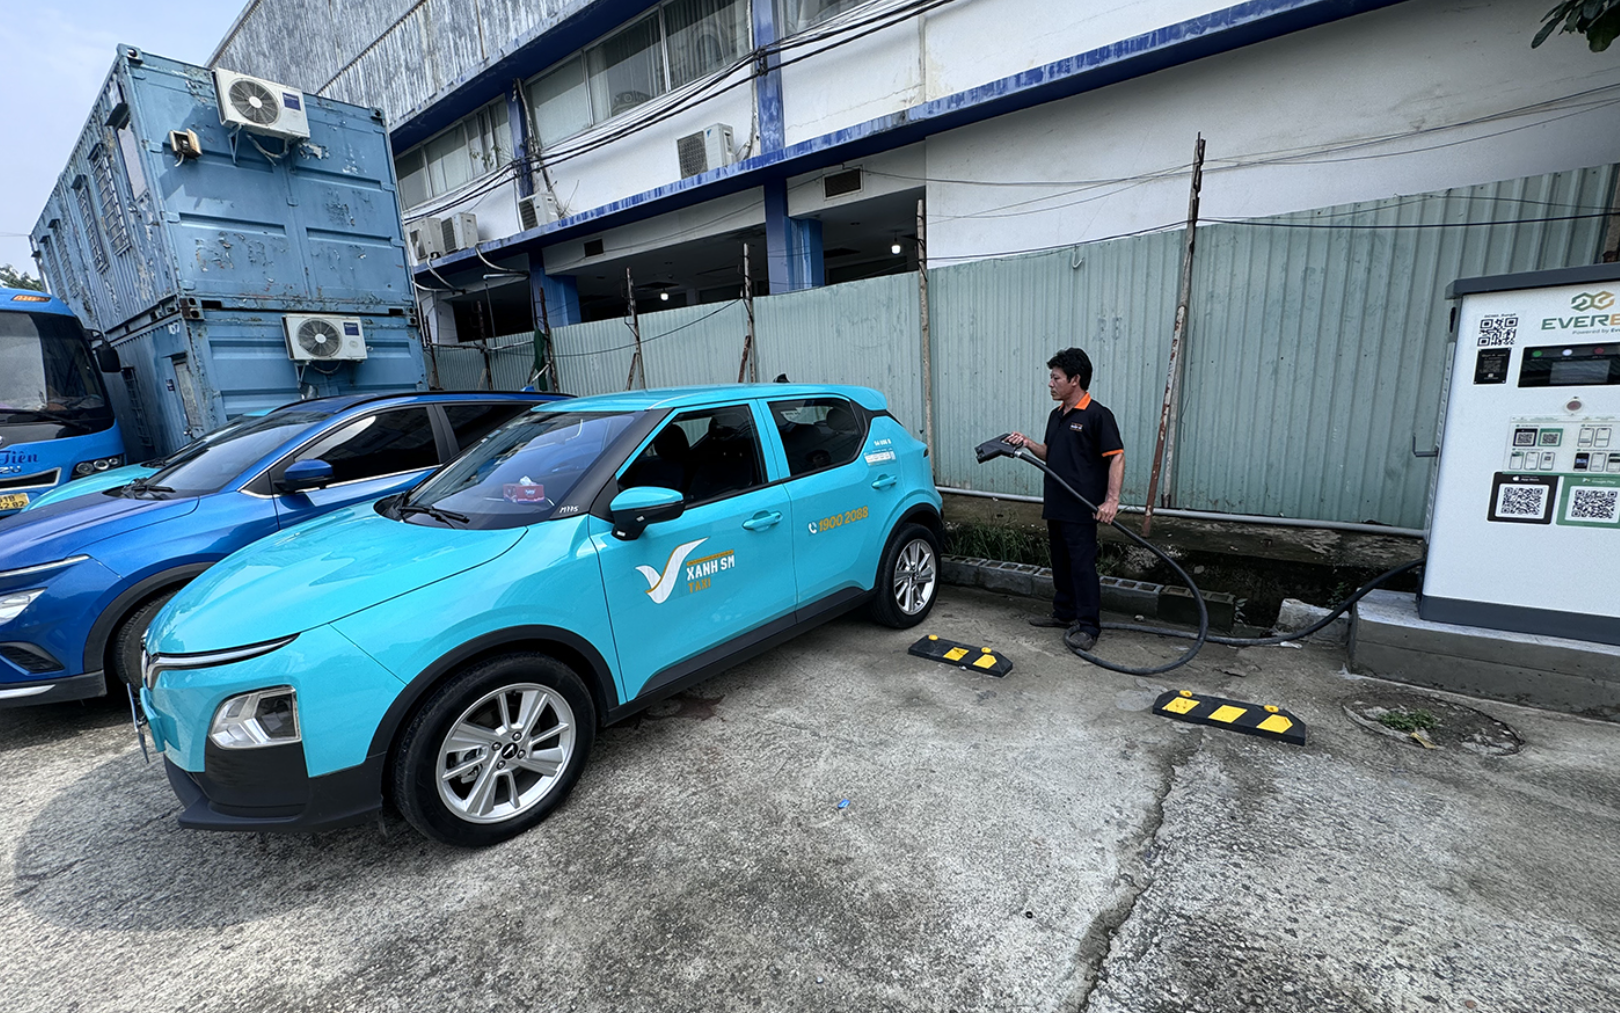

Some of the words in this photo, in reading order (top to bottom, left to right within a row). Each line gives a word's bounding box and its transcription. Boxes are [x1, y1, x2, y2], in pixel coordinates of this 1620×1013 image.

[818, 513, 843, 532] 1900
[844, 505, 869, 525] 2088
[686, 559, 718, 581] XANH
[720, 555, 736, 571] SM
[688, 577, 711, 594] TAXI
